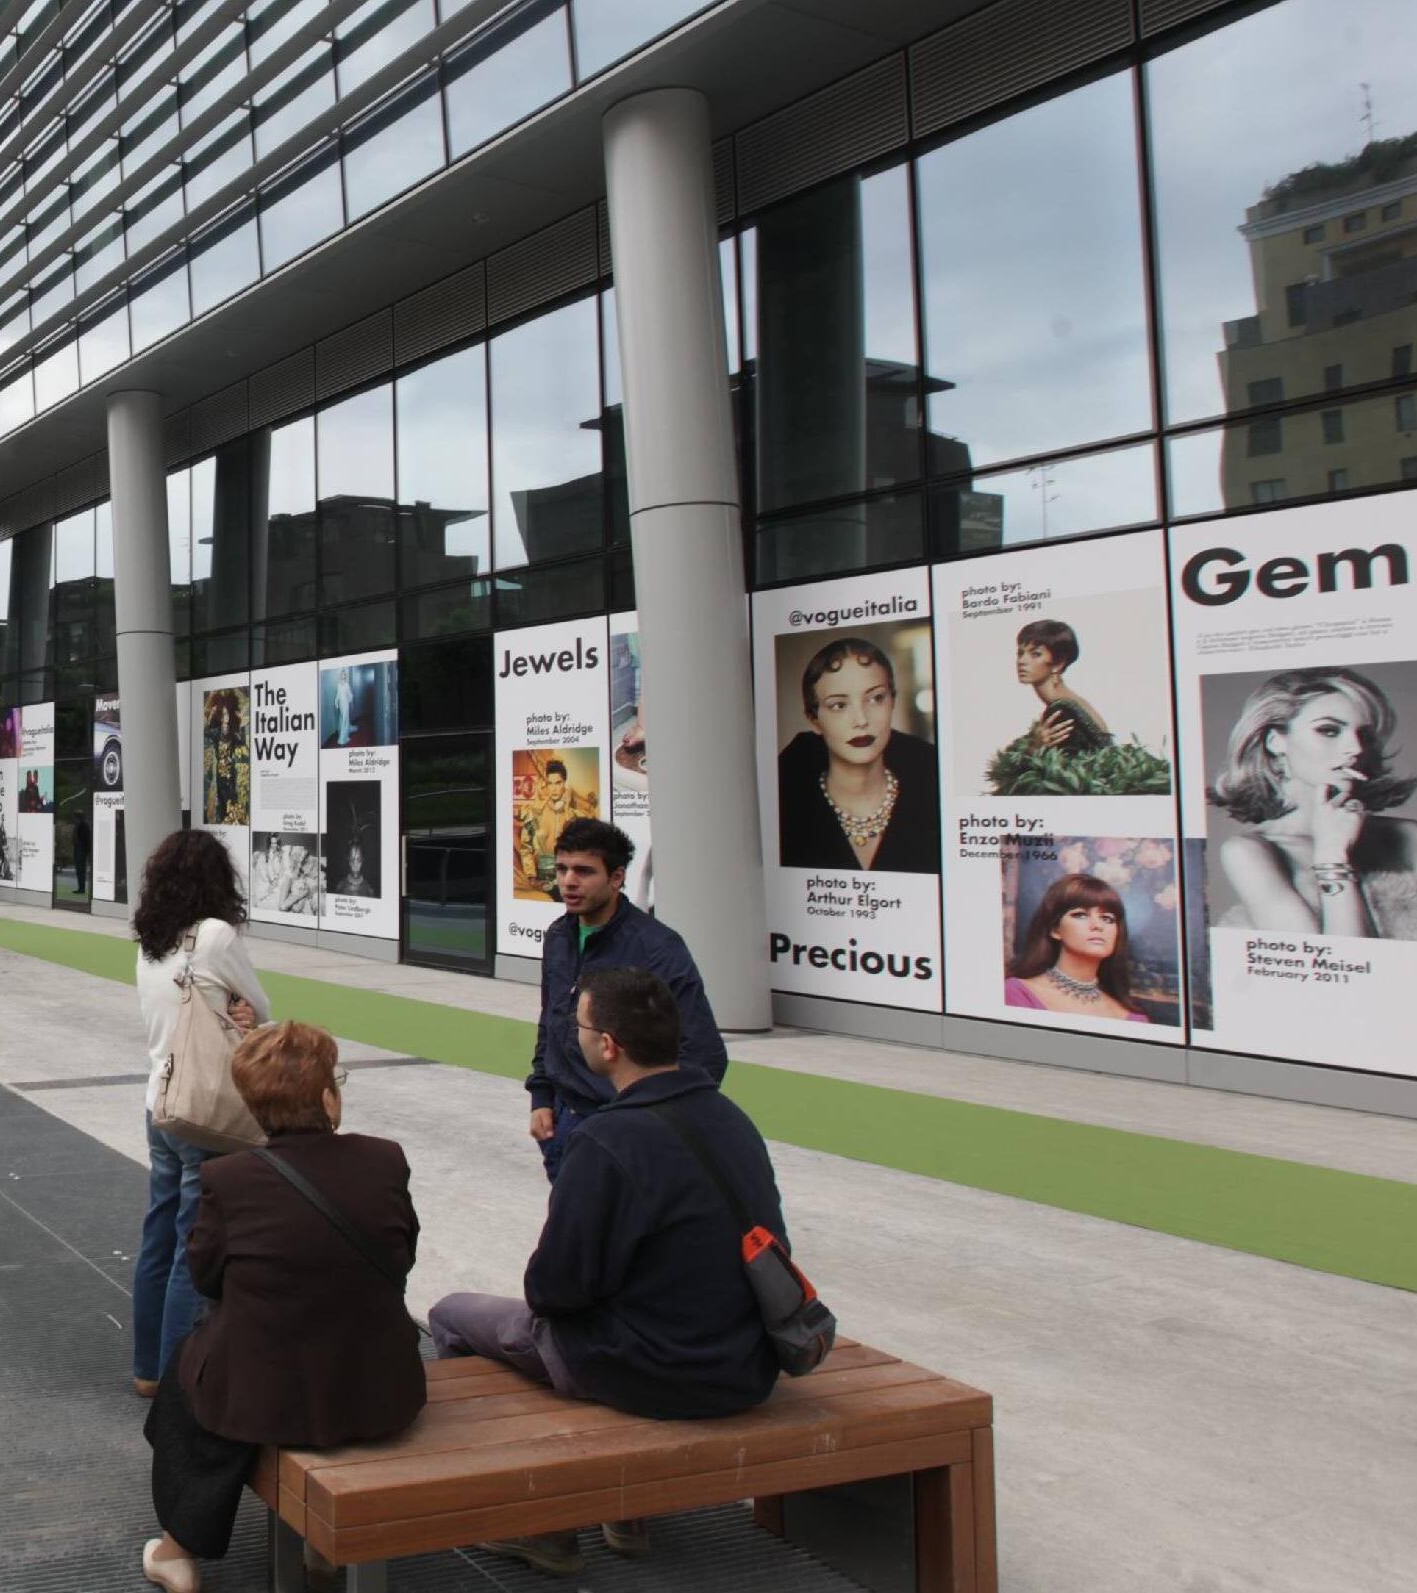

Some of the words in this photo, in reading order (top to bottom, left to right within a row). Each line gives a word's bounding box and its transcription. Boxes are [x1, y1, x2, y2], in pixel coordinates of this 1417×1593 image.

[1182, 543, 1408, 606] Gem
[961, 585, 997, 598] photo
[1001, 581, 1022, 593] by:
[789, 596, 917, 626] @vogueitalia
[498, 637, 599, 678] Jewels
[254, 680, 287, 707] The
[255, 705, 315, 734] Italian
[526, 713, 553, 725] photo
[552, 722, 594, 736] Aldridge
[254, 736, 299, 768] Way
[959, 812, 1008, 830] photo
[1015, 813, 1044, 832] by:
[959, 832, 1000, 845] Enzo
[959, 848, 1022, 860] December
[1025, 850, 1058, 861] 1966
[806, 874, 847, 891] photo
[852, 877, 876, 893] by:
[806, 891, 853, 906] Arthur
[857, 894, 902, 911] Elgort
[806, 906, 846, 917] October
[850, 909, 876, 920] 1993
[770, 932, 933, 981] Precious
[1246, 937, 1297, 952] photo
[1303, 941, 1333, 957] by:
[1247, 952, 1305, 968] Steven
[1312, 958, 1371, 974] Meisel
[1247, 965, 1309, 983] February
[1314, 971, 1350, 984] 2011
